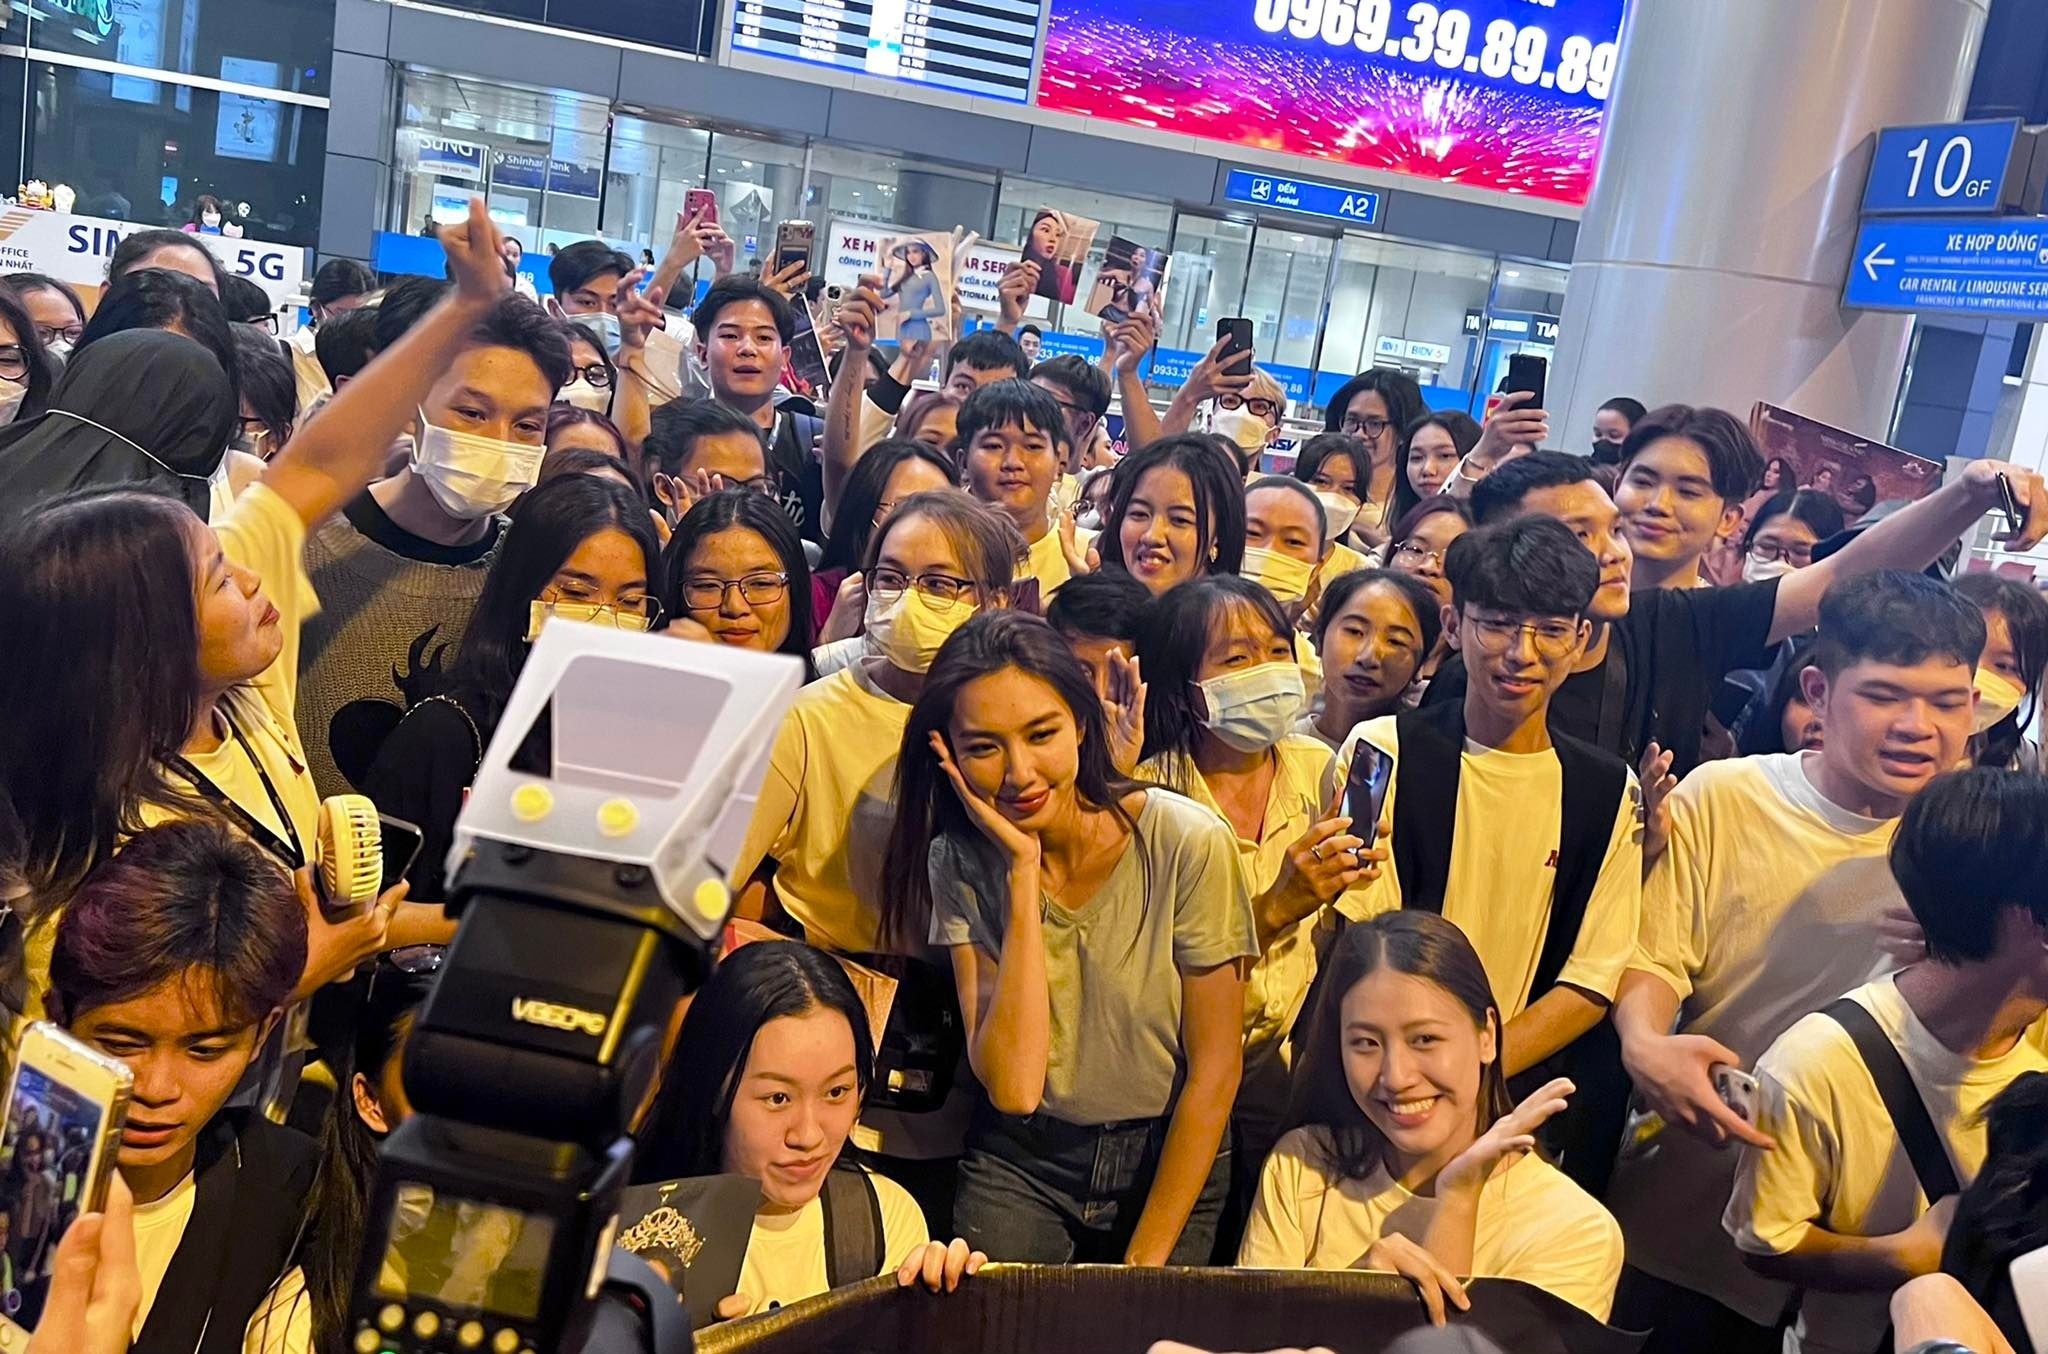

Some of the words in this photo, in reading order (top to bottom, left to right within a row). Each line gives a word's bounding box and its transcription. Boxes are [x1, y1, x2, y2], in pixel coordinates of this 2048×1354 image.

[1907, 136, 1972, 197] 10
[1965, 180, 1992, 198] GF
[1275, 195, 1299, 206] Arrival
[1339, 195, 1369, 218] A2
[842, 236, 860, 250] XE
[1946, 233, 1964, 251] XE
[1965, 233, 1994, 256] HỢP
[236, 249, 284, 280] 5G
[838, 255, 861, 266] CÔNG
[1899, 278, 1918, 292] CAR
[1920, 278, 1957, 293] RENTAL
[1967, 280, 2027, 295] LIMOUSINE
